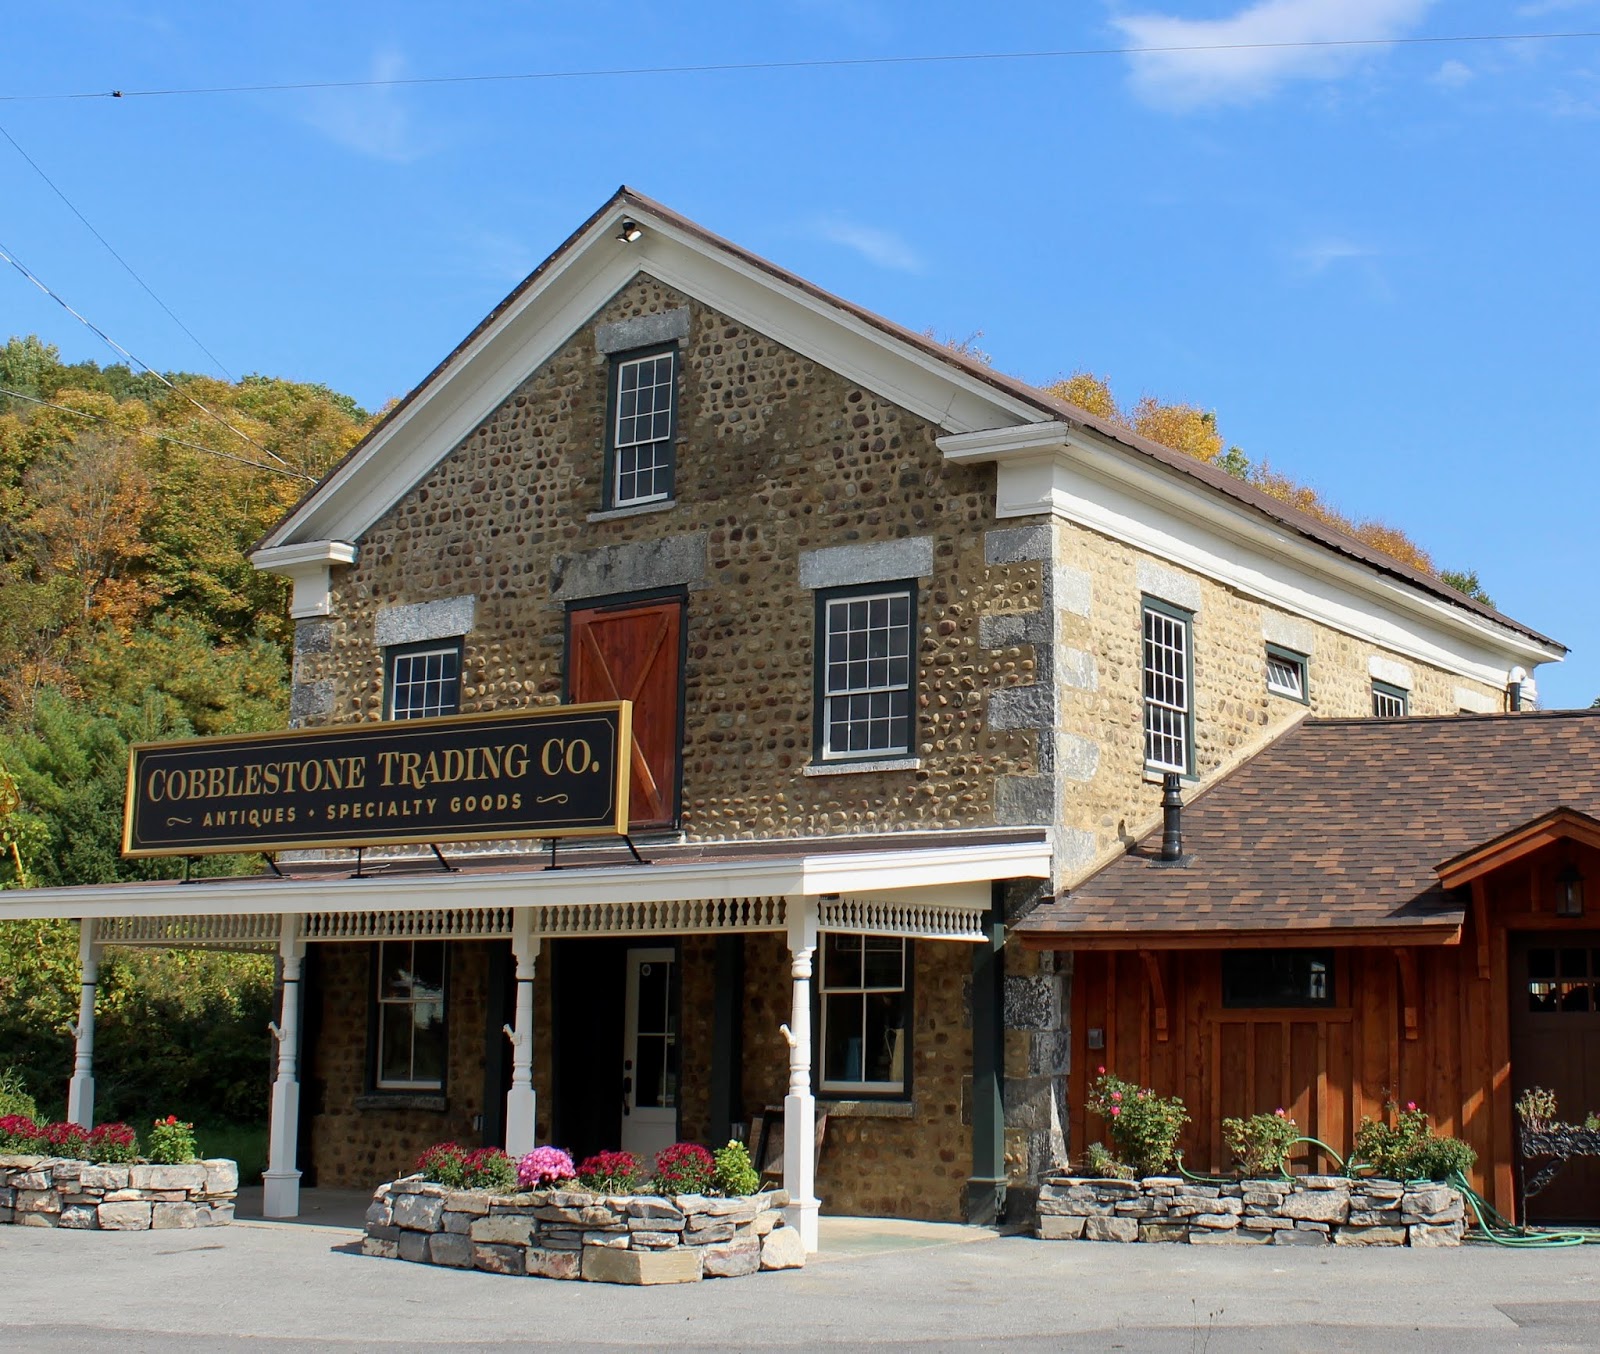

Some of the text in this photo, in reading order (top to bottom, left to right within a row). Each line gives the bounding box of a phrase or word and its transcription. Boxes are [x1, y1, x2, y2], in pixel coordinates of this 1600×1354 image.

[147, 737, 600, 801] COBBLESTONE TRADING CO.
[202, 793, 523, 828] ANTIQUES SPECIALTY GOODS
